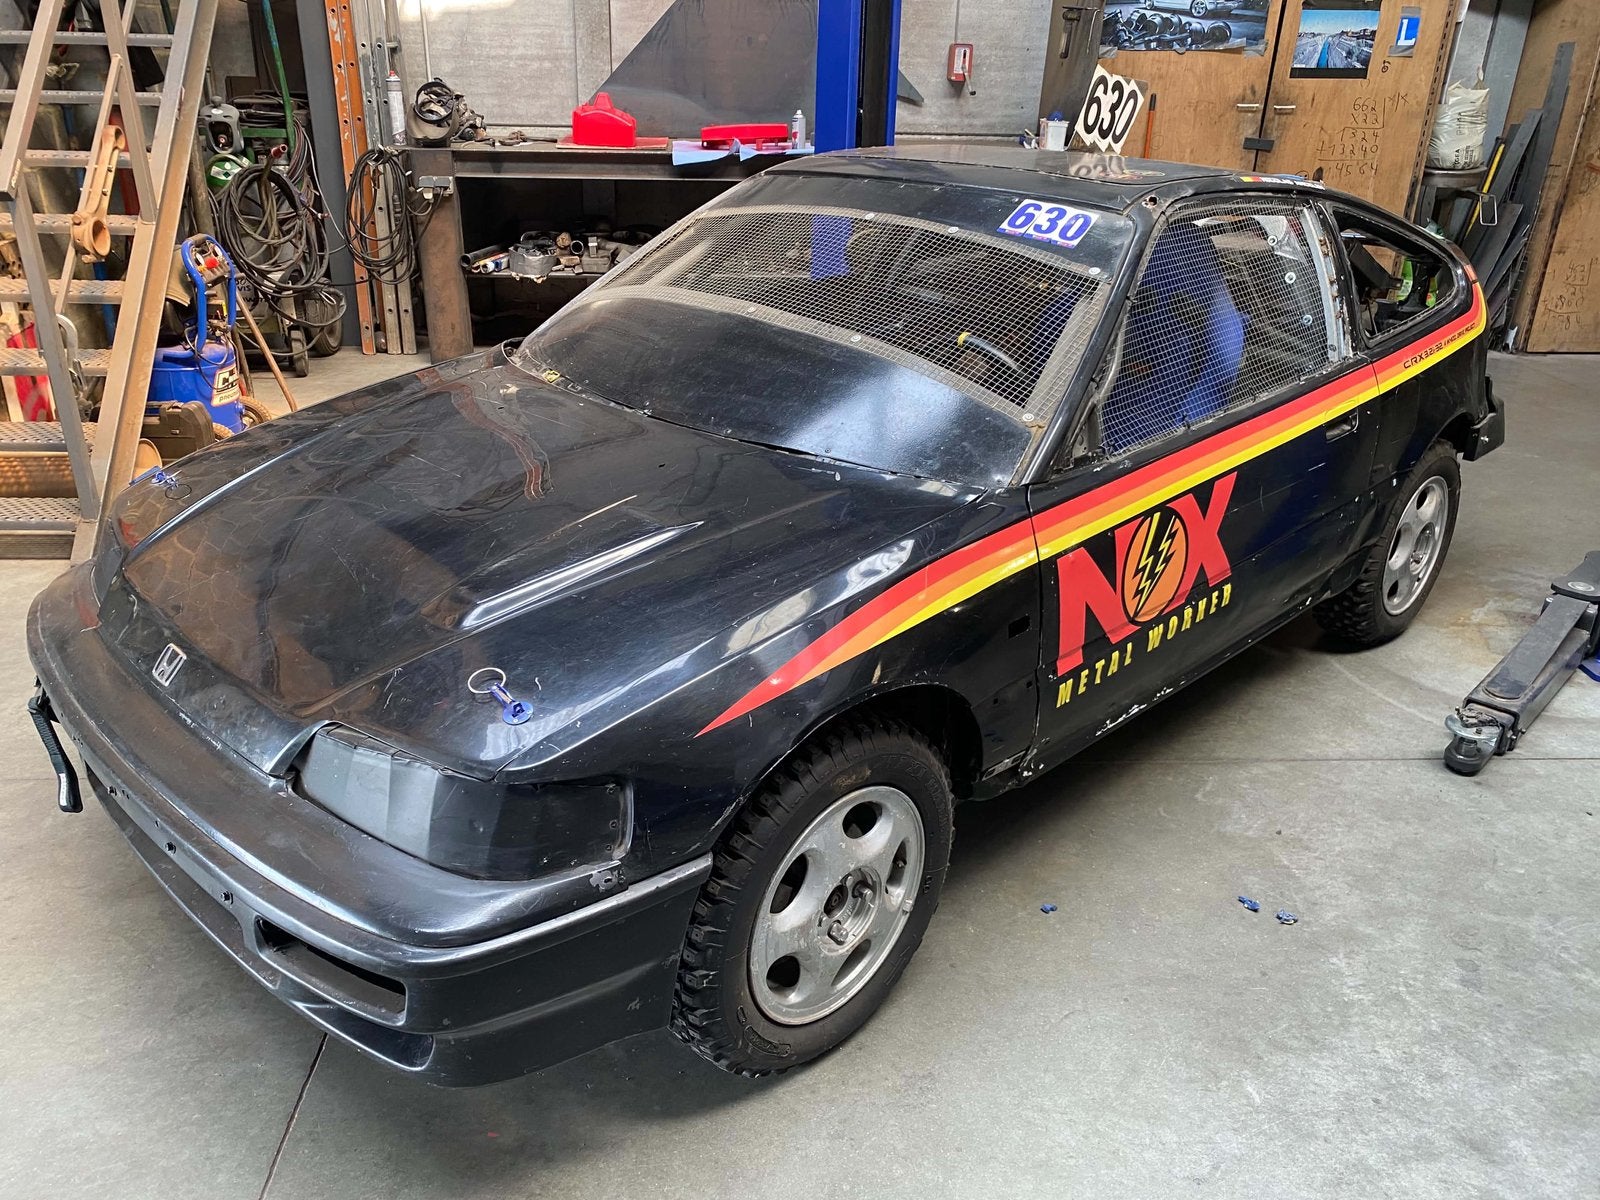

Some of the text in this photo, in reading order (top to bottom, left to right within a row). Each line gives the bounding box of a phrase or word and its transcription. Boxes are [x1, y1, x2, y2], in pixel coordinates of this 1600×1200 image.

[1397, 18, 1416, 46] L
[1083, 74, 1138, 144] 630
[1353, 97, 1377, 112] 662
[1007, 203, 1092, 242] 630
[1056, 471, 1238, 678] NOX
[1056, 582, 1232, 709] METAL WORKER
